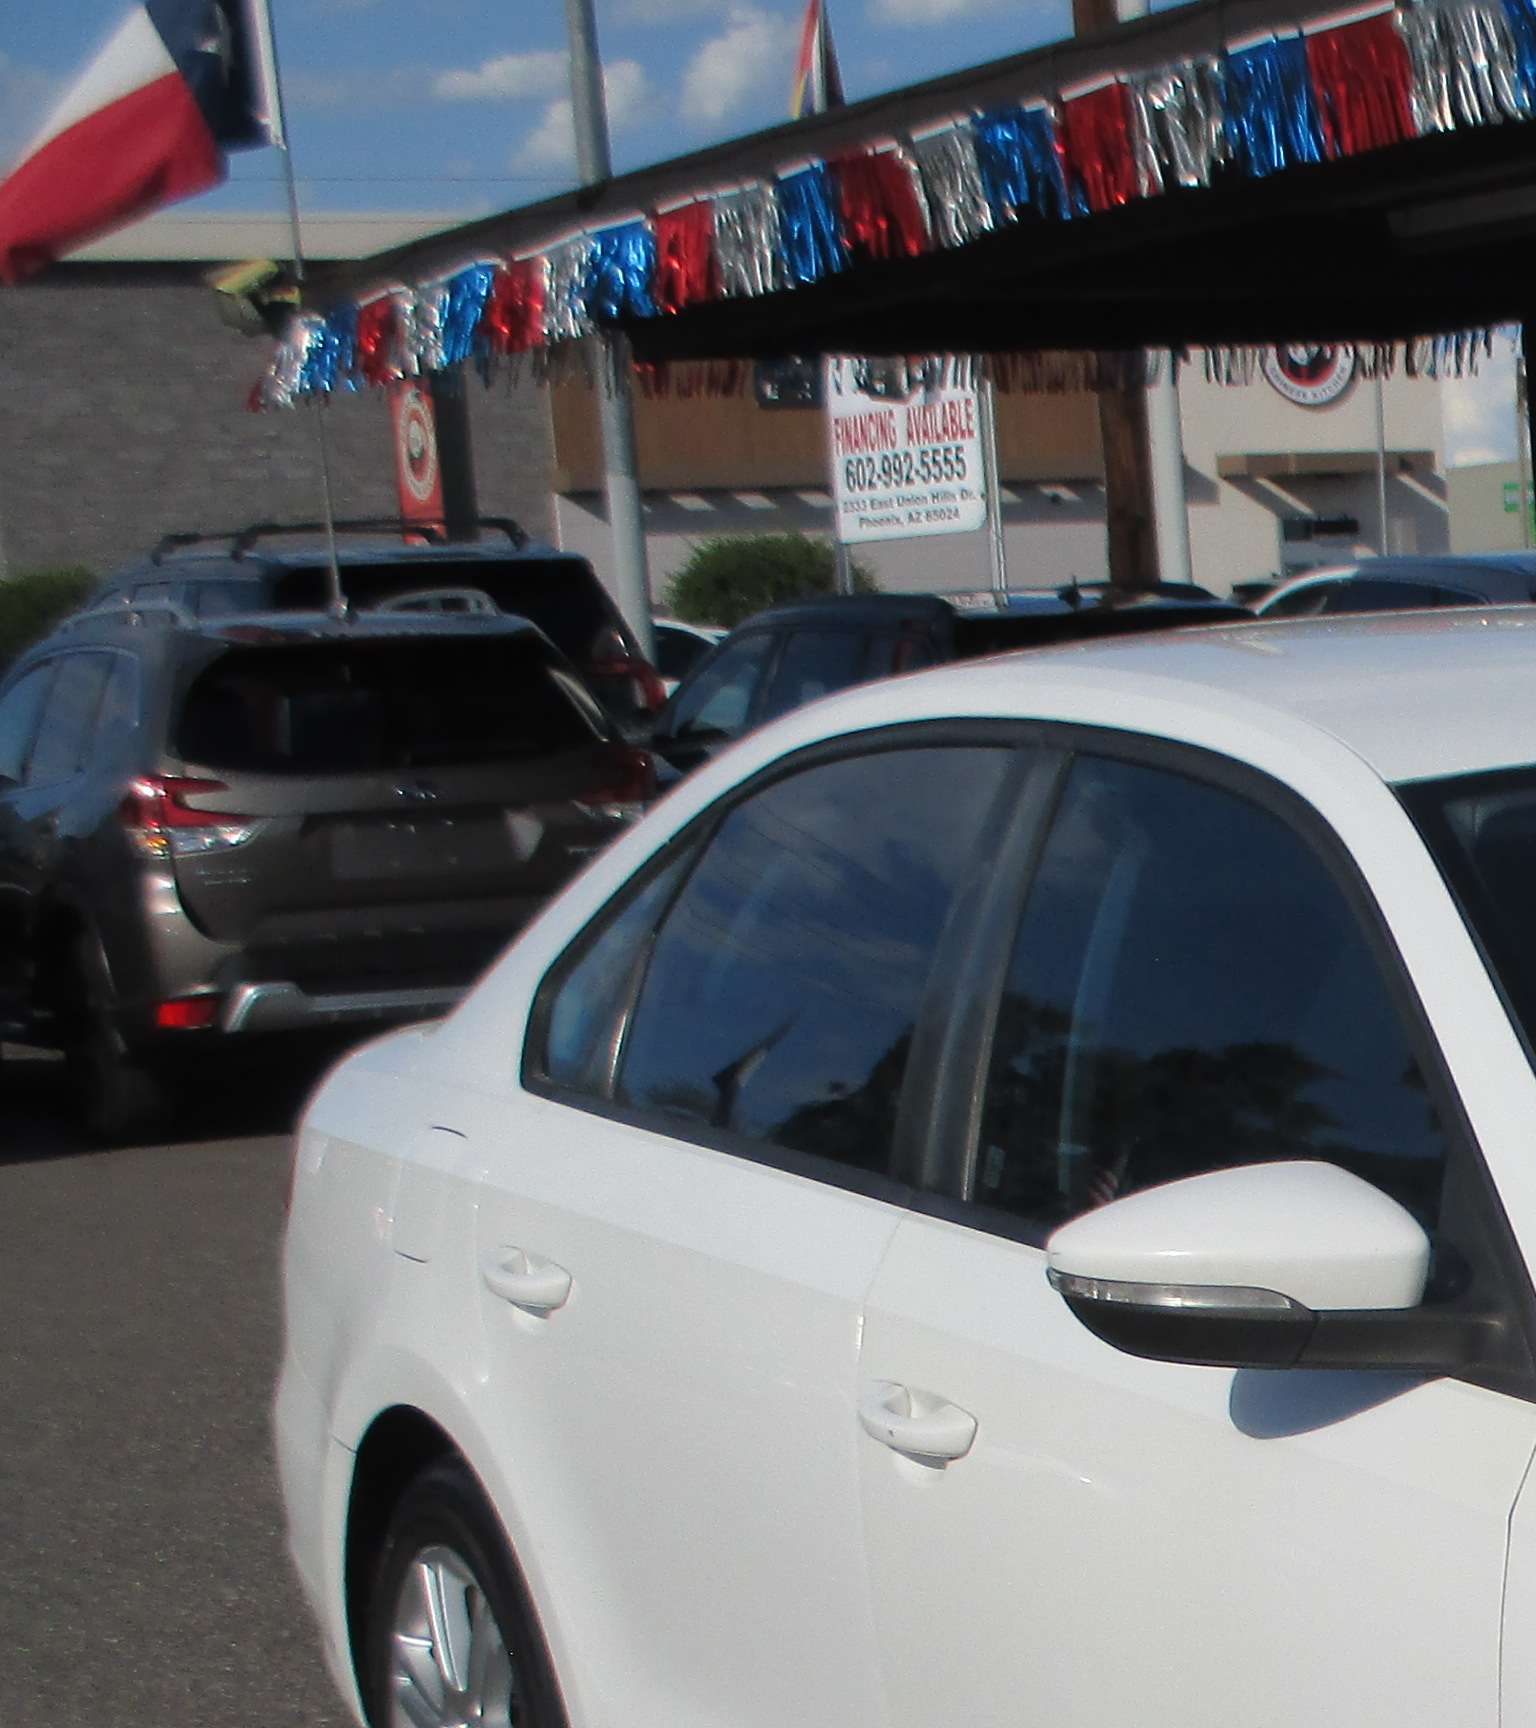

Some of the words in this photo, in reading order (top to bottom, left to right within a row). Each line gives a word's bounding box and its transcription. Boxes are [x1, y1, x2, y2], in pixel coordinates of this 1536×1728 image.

[834, 410, 897, 456] FINANCING
[907, 398, 976, 446] AVAILABLE
[845, 446, 967, 493] 602-992-5555
[870, 498, 893, 511] East
[897, 494, 928, 508] Union
[931, 490, 956, 505] Hills
[908, 511, 922, 525] AZ
